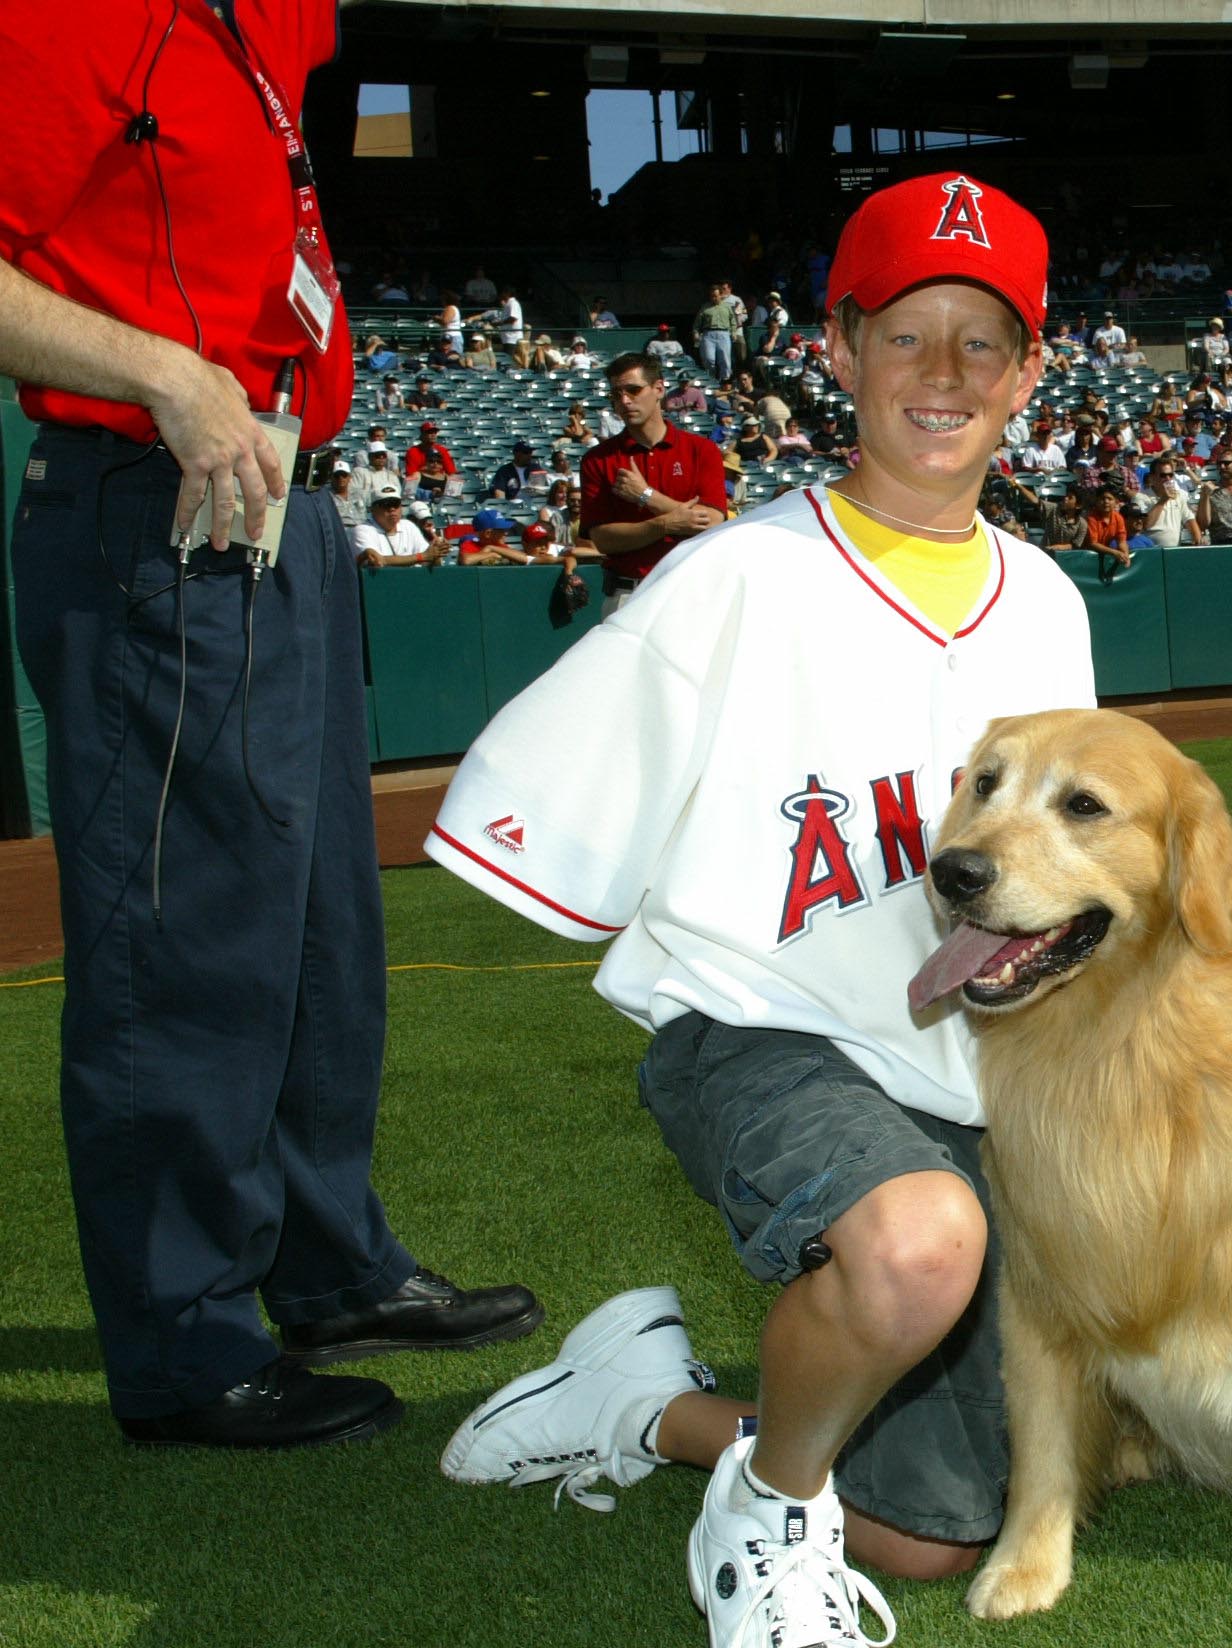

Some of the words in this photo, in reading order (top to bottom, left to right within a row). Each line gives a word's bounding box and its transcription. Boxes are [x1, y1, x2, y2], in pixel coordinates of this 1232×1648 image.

[256, 72, 291, 128] ANGELS
[283, 129, 302, 158] EIM
[929, 175, 992, 250] A
[483, 823, 521, 855] Majestic
[776, 765, 968, 945] AN
[788, 1518, 804, 1539] STAR
